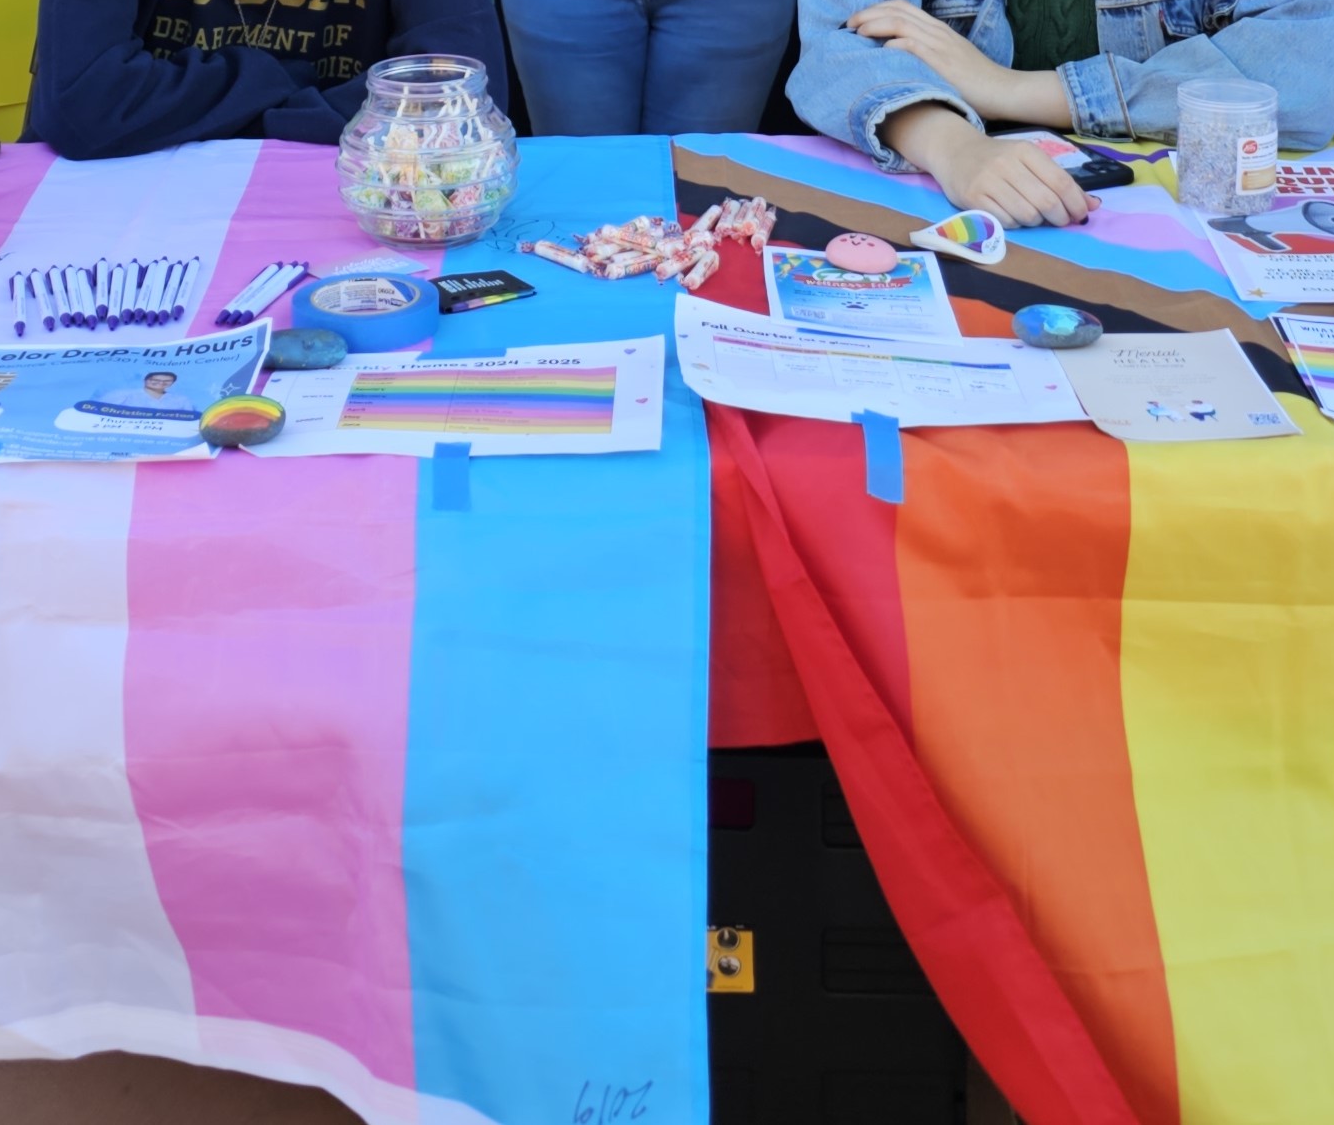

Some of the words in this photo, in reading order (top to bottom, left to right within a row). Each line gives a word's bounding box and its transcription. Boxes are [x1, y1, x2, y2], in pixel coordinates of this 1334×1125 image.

[153, 15, 315, 53] DEARTMENT
[323, 25, 352, 47] OF
[67, 348, 166, 360] Drop-In
[176, 335, 252, 357] Hours
[474, 359, 518, 368] 2024
[537, 357, 581, 366] 2025
